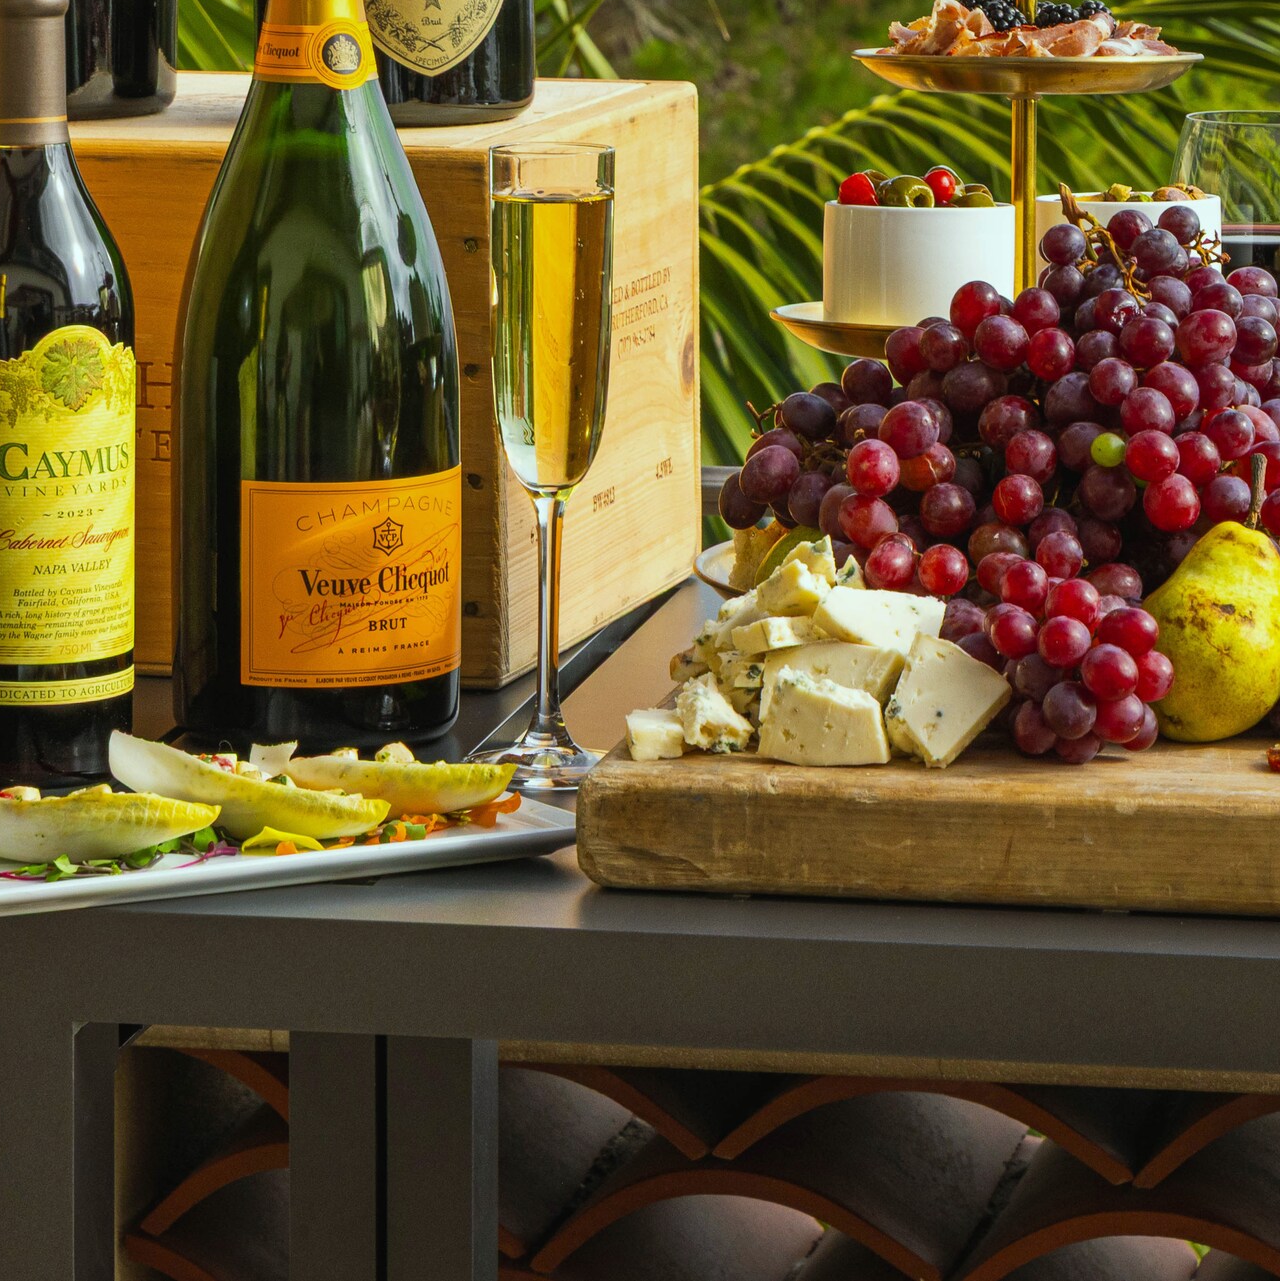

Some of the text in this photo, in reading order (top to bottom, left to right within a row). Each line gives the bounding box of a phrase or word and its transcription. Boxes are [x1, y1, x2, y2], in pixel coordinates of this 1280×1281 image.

[421, 16, 443, 26] Brut
[262, 41, 300, 59] Clicquot
[413, 55, 450, 66] SPECIMEN
[631, 270, 661, 297] BOTTLED
[4, 476, 127, 497] VINEYARDS
[57, 508, 93, 519] 2023
[296, 495, 454, 532] CHAMPAGNE
[69, 523, 130, 553] Sauvignon
[379, 533, 398, 543] VCP
[33, 558, 112, 575] NAPA VALLEY
[298, 561, 450, 596] Veuve Clicquot
[13, 588, 45, 598] Bottled
[47, 588, 57, 599] by
[60, 587, 91, 597] Caymus
[17, 598, 59, 608] Fairfield,
[25, 611, 43, 621] long
[45, 609, 71, 620] history
[368, 618, 408, 632] BRUT
[8, 630, 21, 639] the
[23, 630, 53, 640] Wagner
[54, 629, 79, 640] family
[352, 645, 388, 654] REIMS
[394, 640, 430, 651] FRANCE
[60, 688, 77, 699] TO
